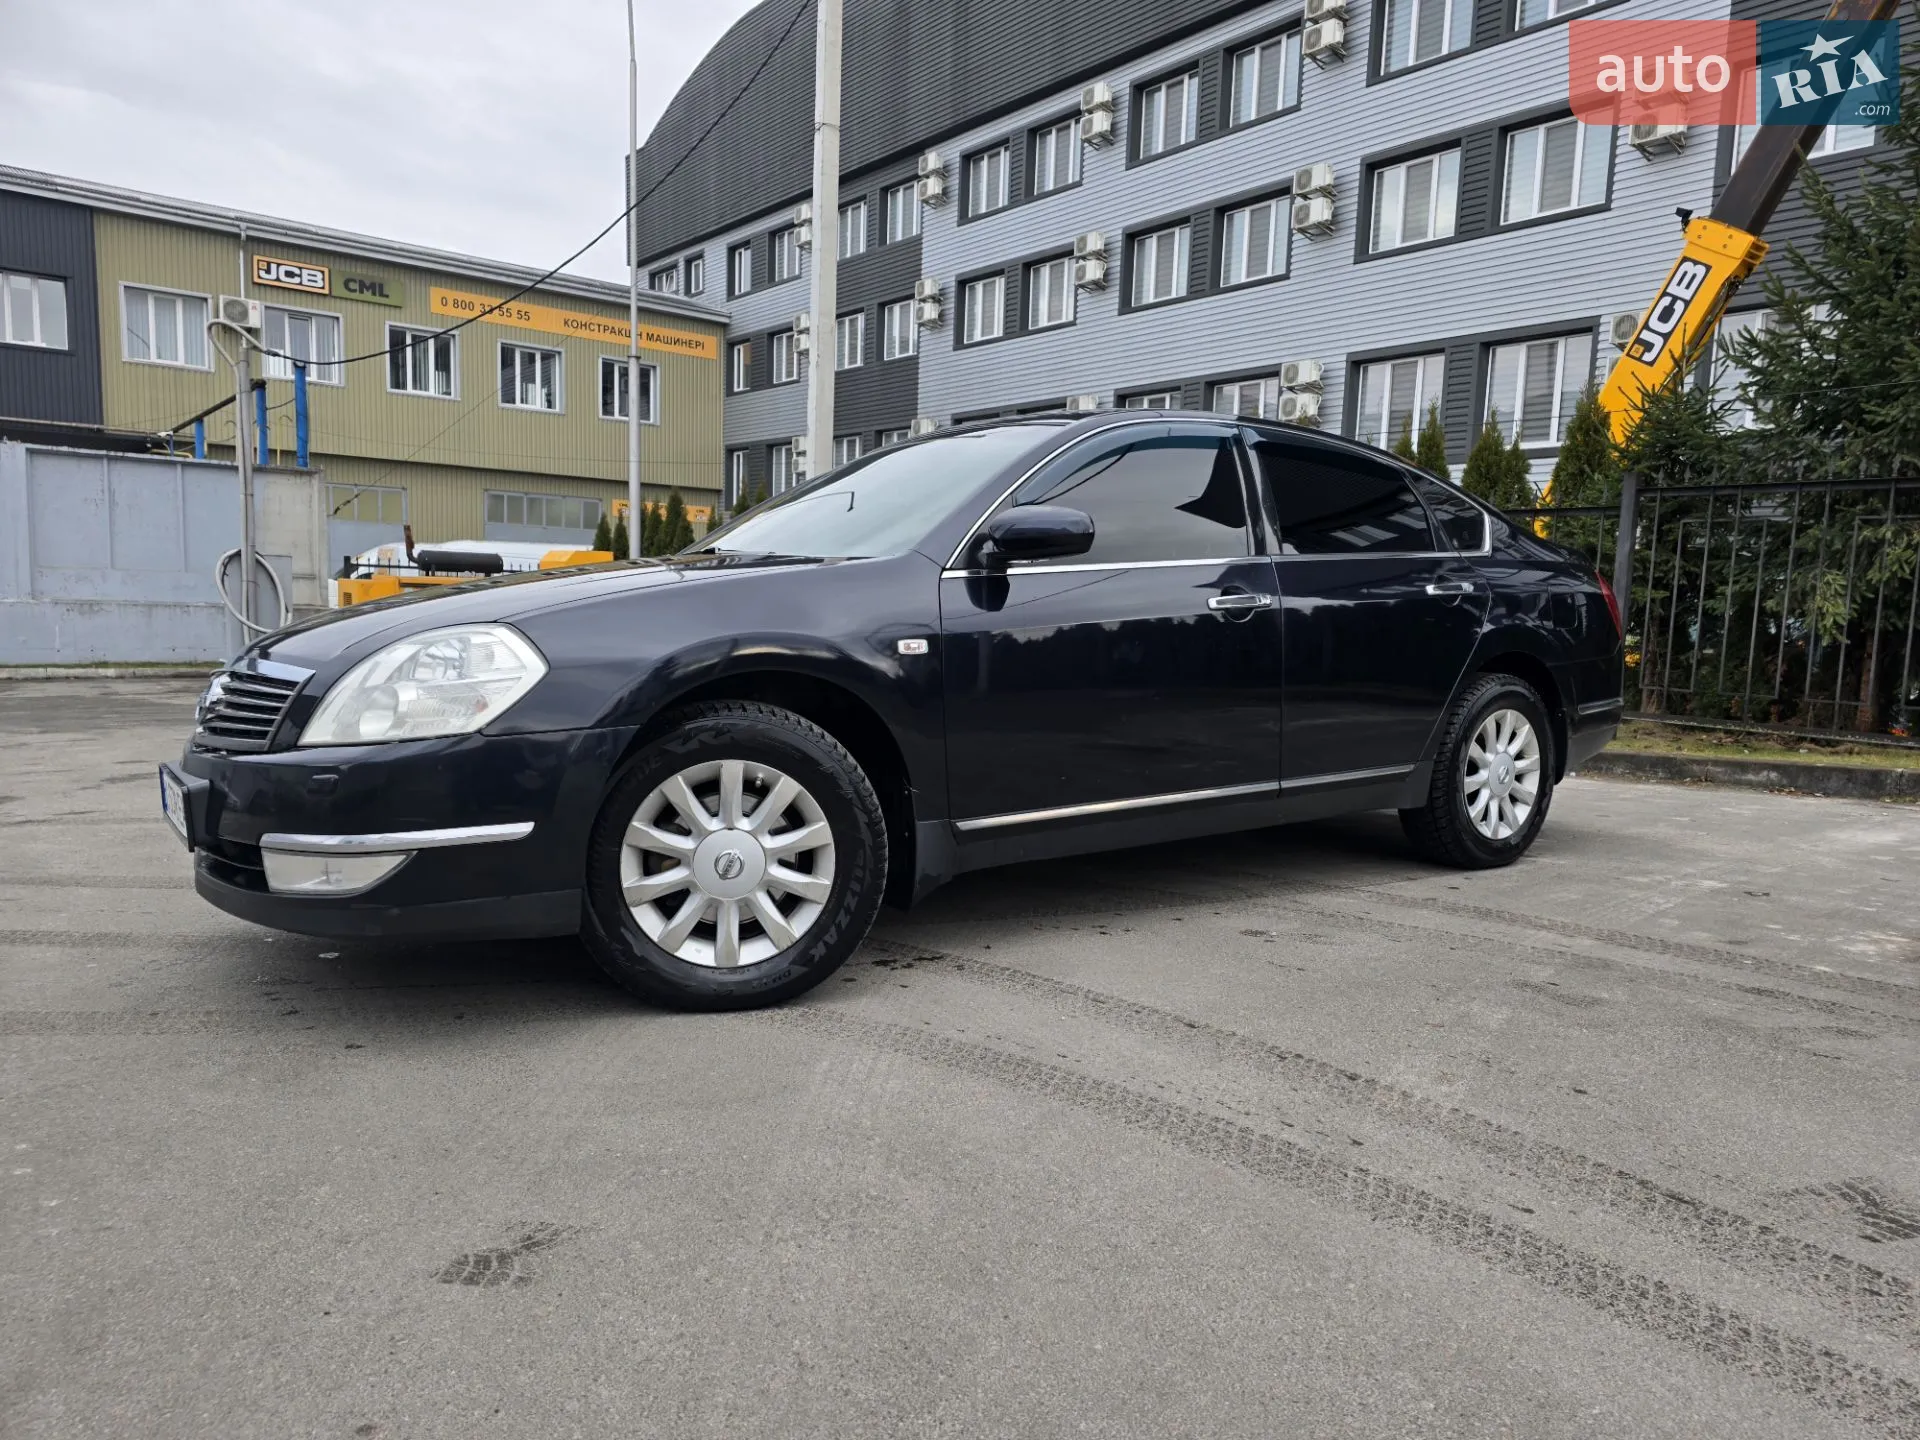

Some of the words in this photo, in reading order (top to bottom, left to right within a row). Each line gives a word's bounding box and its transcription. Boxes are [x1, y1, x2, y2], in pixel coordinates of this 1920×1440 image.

[258, 261, 325, 289] JCB
[343, 277, 390, 299] CML
[440, 296, 448, 307] 0
[452, 298, 475, 312] 800
[498, 306, 513, 318] 55
[516, 309, 531, 321] 55
[1639, 261, 1707, 362] JCB
[563, 318, 643, 341] КОНСТРАКЦН
[646, 332, 706, 351] МАШИНЕРІ
